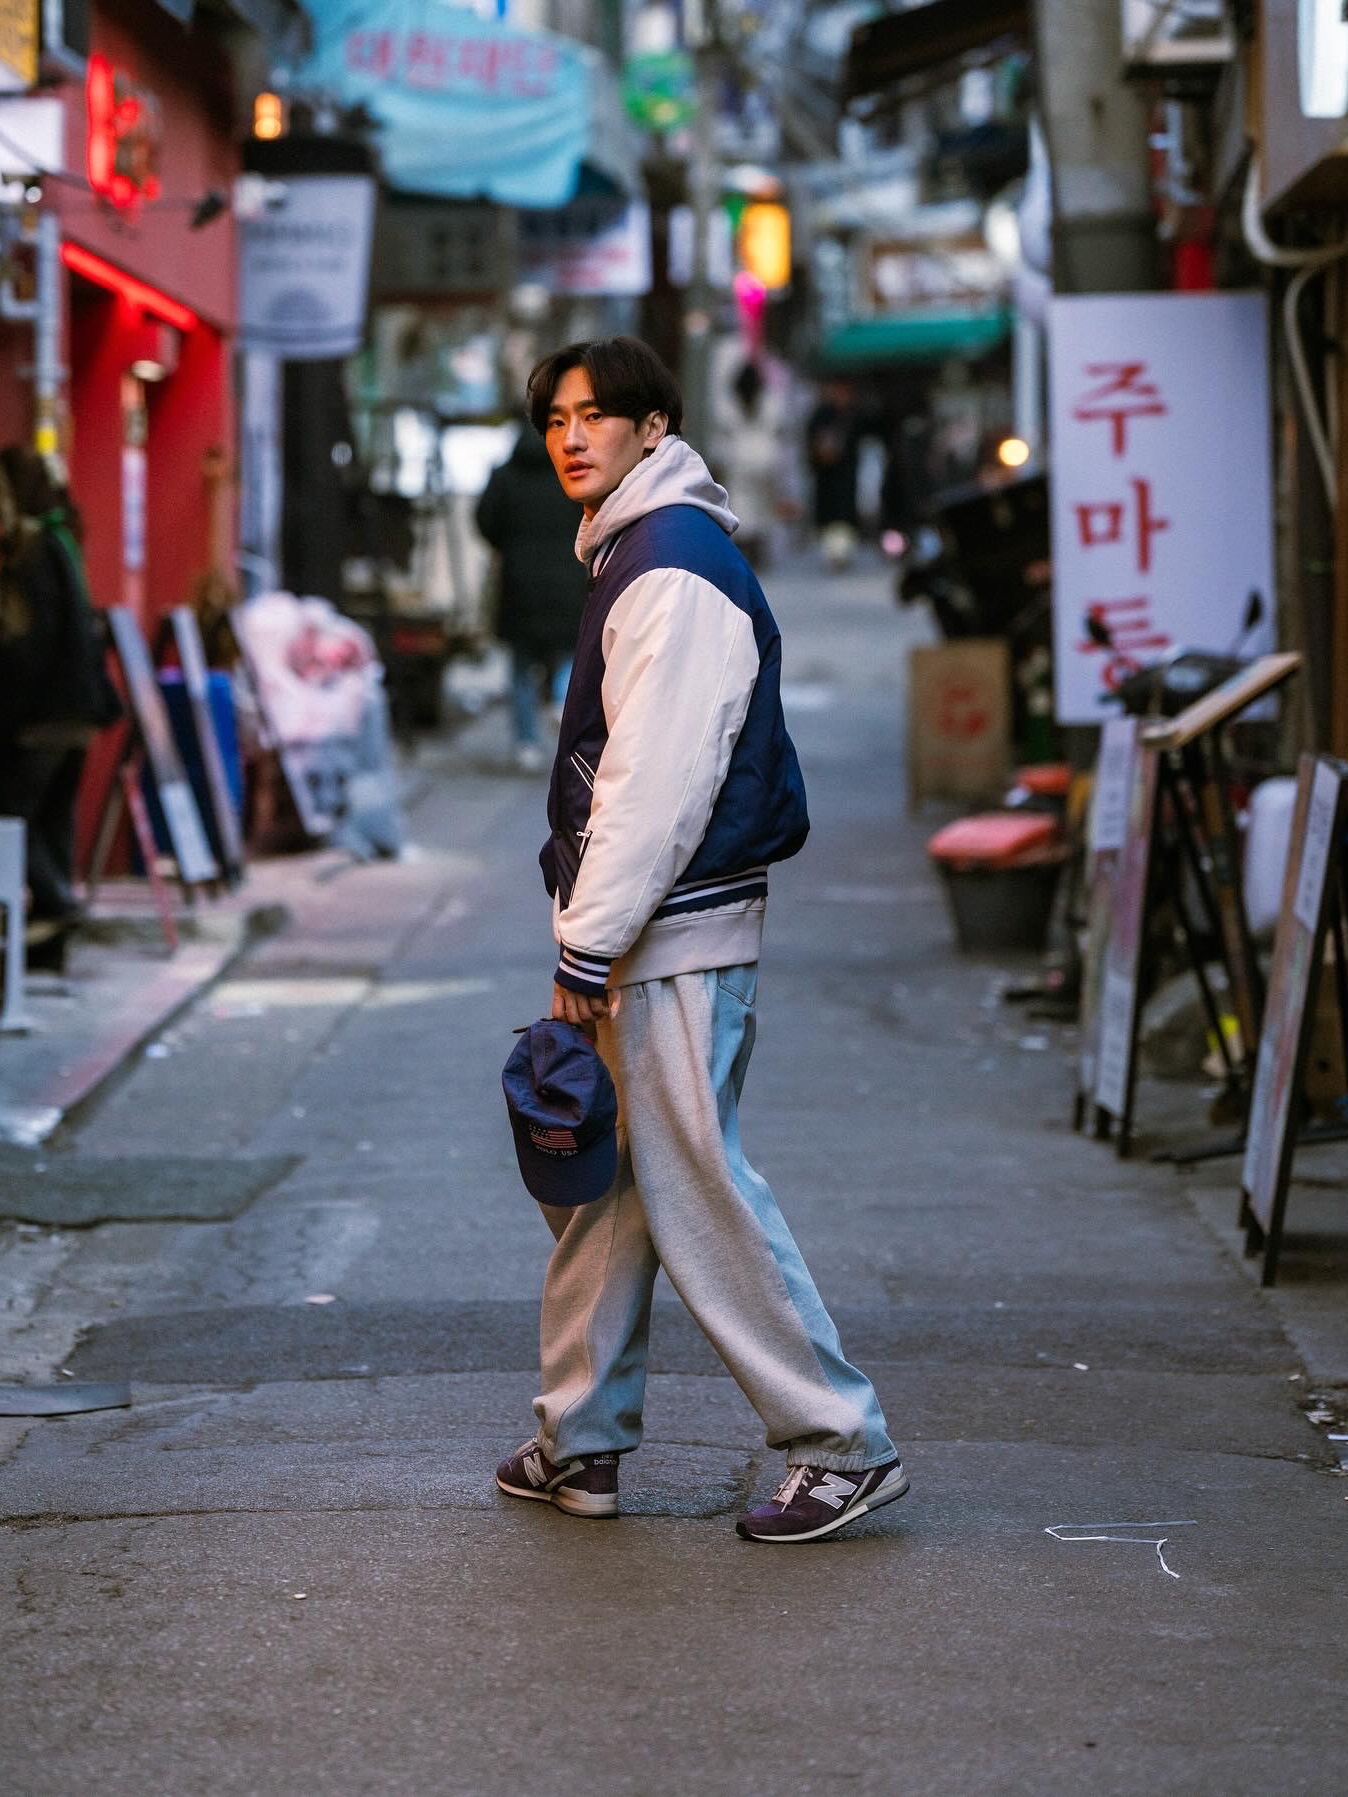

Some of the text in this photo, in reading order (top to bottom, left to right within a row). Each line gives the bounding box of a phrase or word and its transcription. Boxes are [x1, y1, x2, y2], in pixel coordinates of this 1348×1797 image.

[1074, 361, 1170, 693] 주마등
[523, 1452, 548, 1487] N
[808, 1472, 858, 1510] N
